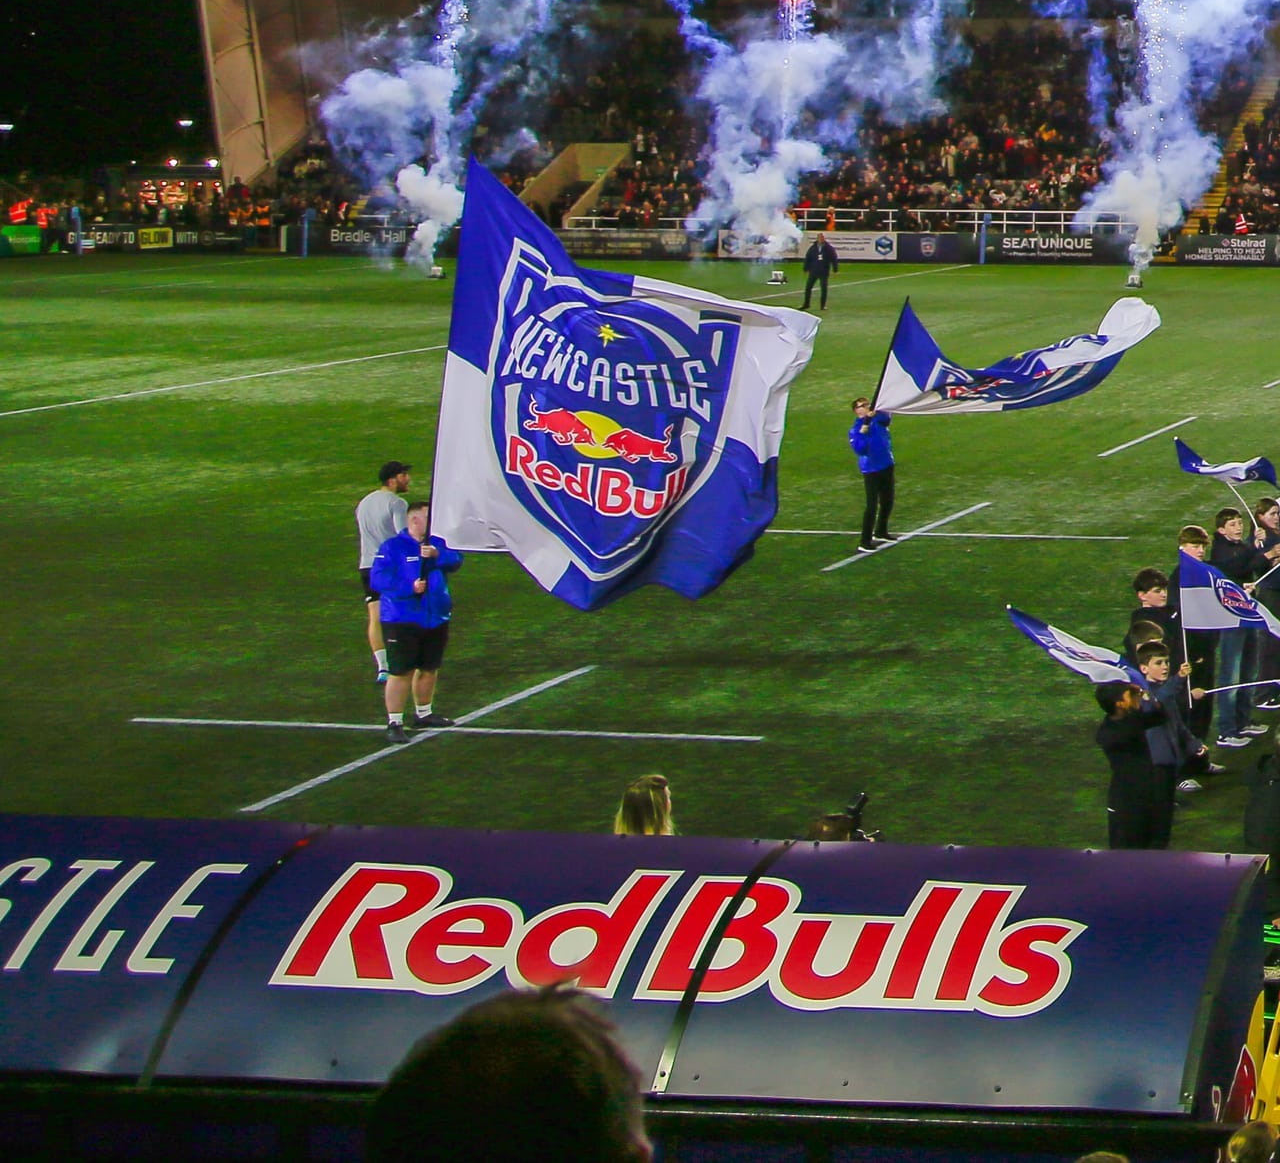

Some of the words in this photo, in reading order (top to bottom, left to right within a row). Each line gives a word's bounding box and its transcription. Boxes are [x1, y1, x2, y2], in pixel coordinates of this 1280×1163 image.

[122, 232, 135, 244] TO
[176, 231, 198, 244] WITH
[382, 229, 406, 243] Hall
[1002, 237, 1037, 249] SEAT
[1039, 237, 1093, 249] UNIQUE
[1230, 238, 1266, 248] Stelrad
[1185, 253, 1213, 261] HOMES
[1214, 253, 1266, 261] SUSTAINABLY
[1198, 247, 1233, 255] HELPING
[1234, 247, 1244, 255] TO
[1245, 247, 1266, 255] HEAT
[500, 314, 711, 423] NEWCASTLE
